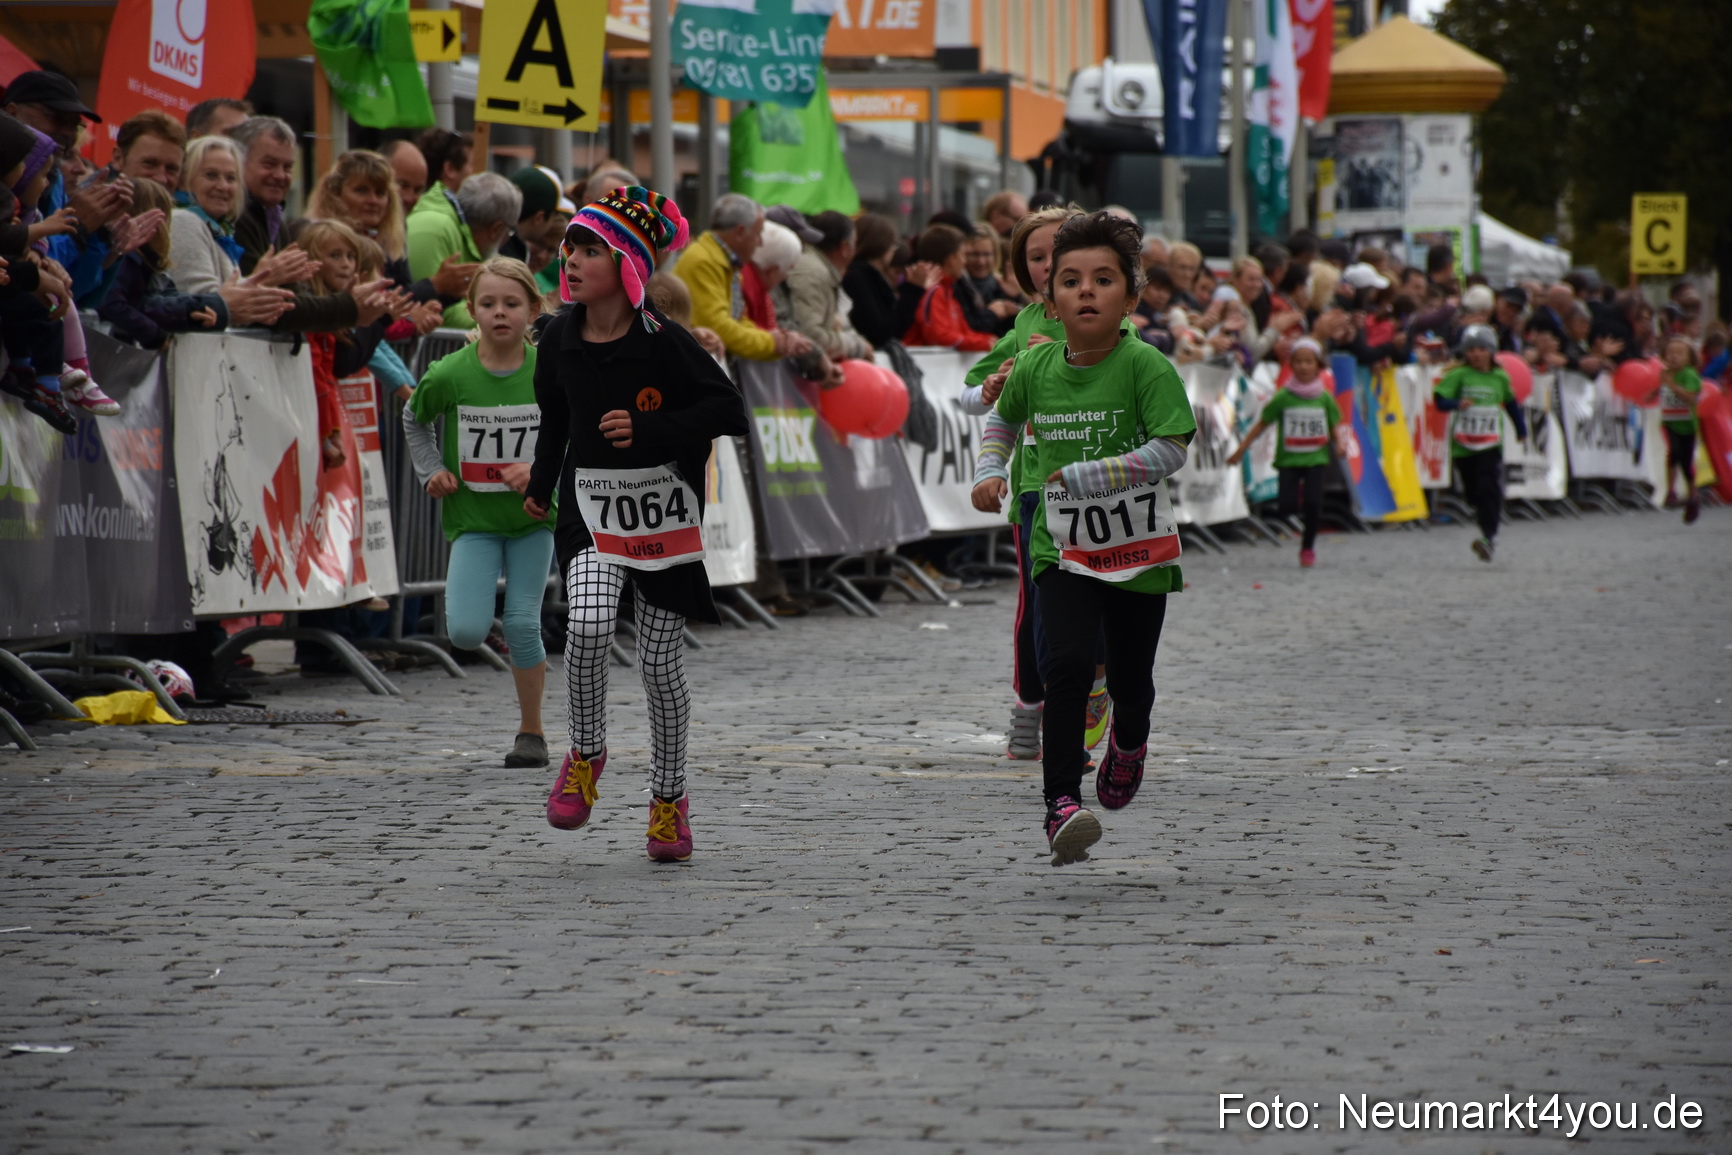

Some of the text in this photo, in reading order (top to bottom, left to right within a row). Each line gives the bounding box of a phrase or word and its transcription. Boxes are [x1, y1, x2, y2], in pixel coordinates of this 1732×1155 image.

[504, 0, 575, 89] A
[154, 40, 199, 78] DKMS
[1644, 217, 1671, 257] C
[460, 413, 539, 424] PARTL Neumarkt
[1034, 410, 1107, 424] Neumarkter
[1037, 426, 1092, 441] Stadtlauf
[578, 474, 675, 490] PARTL Neumarkt
[590, 487, 689, 531] 7064
[1058, 492, 1157, 547] 7017
[624, 541, 665, 557] Luisa
[1087, 549, 1150, 570] Melissa
